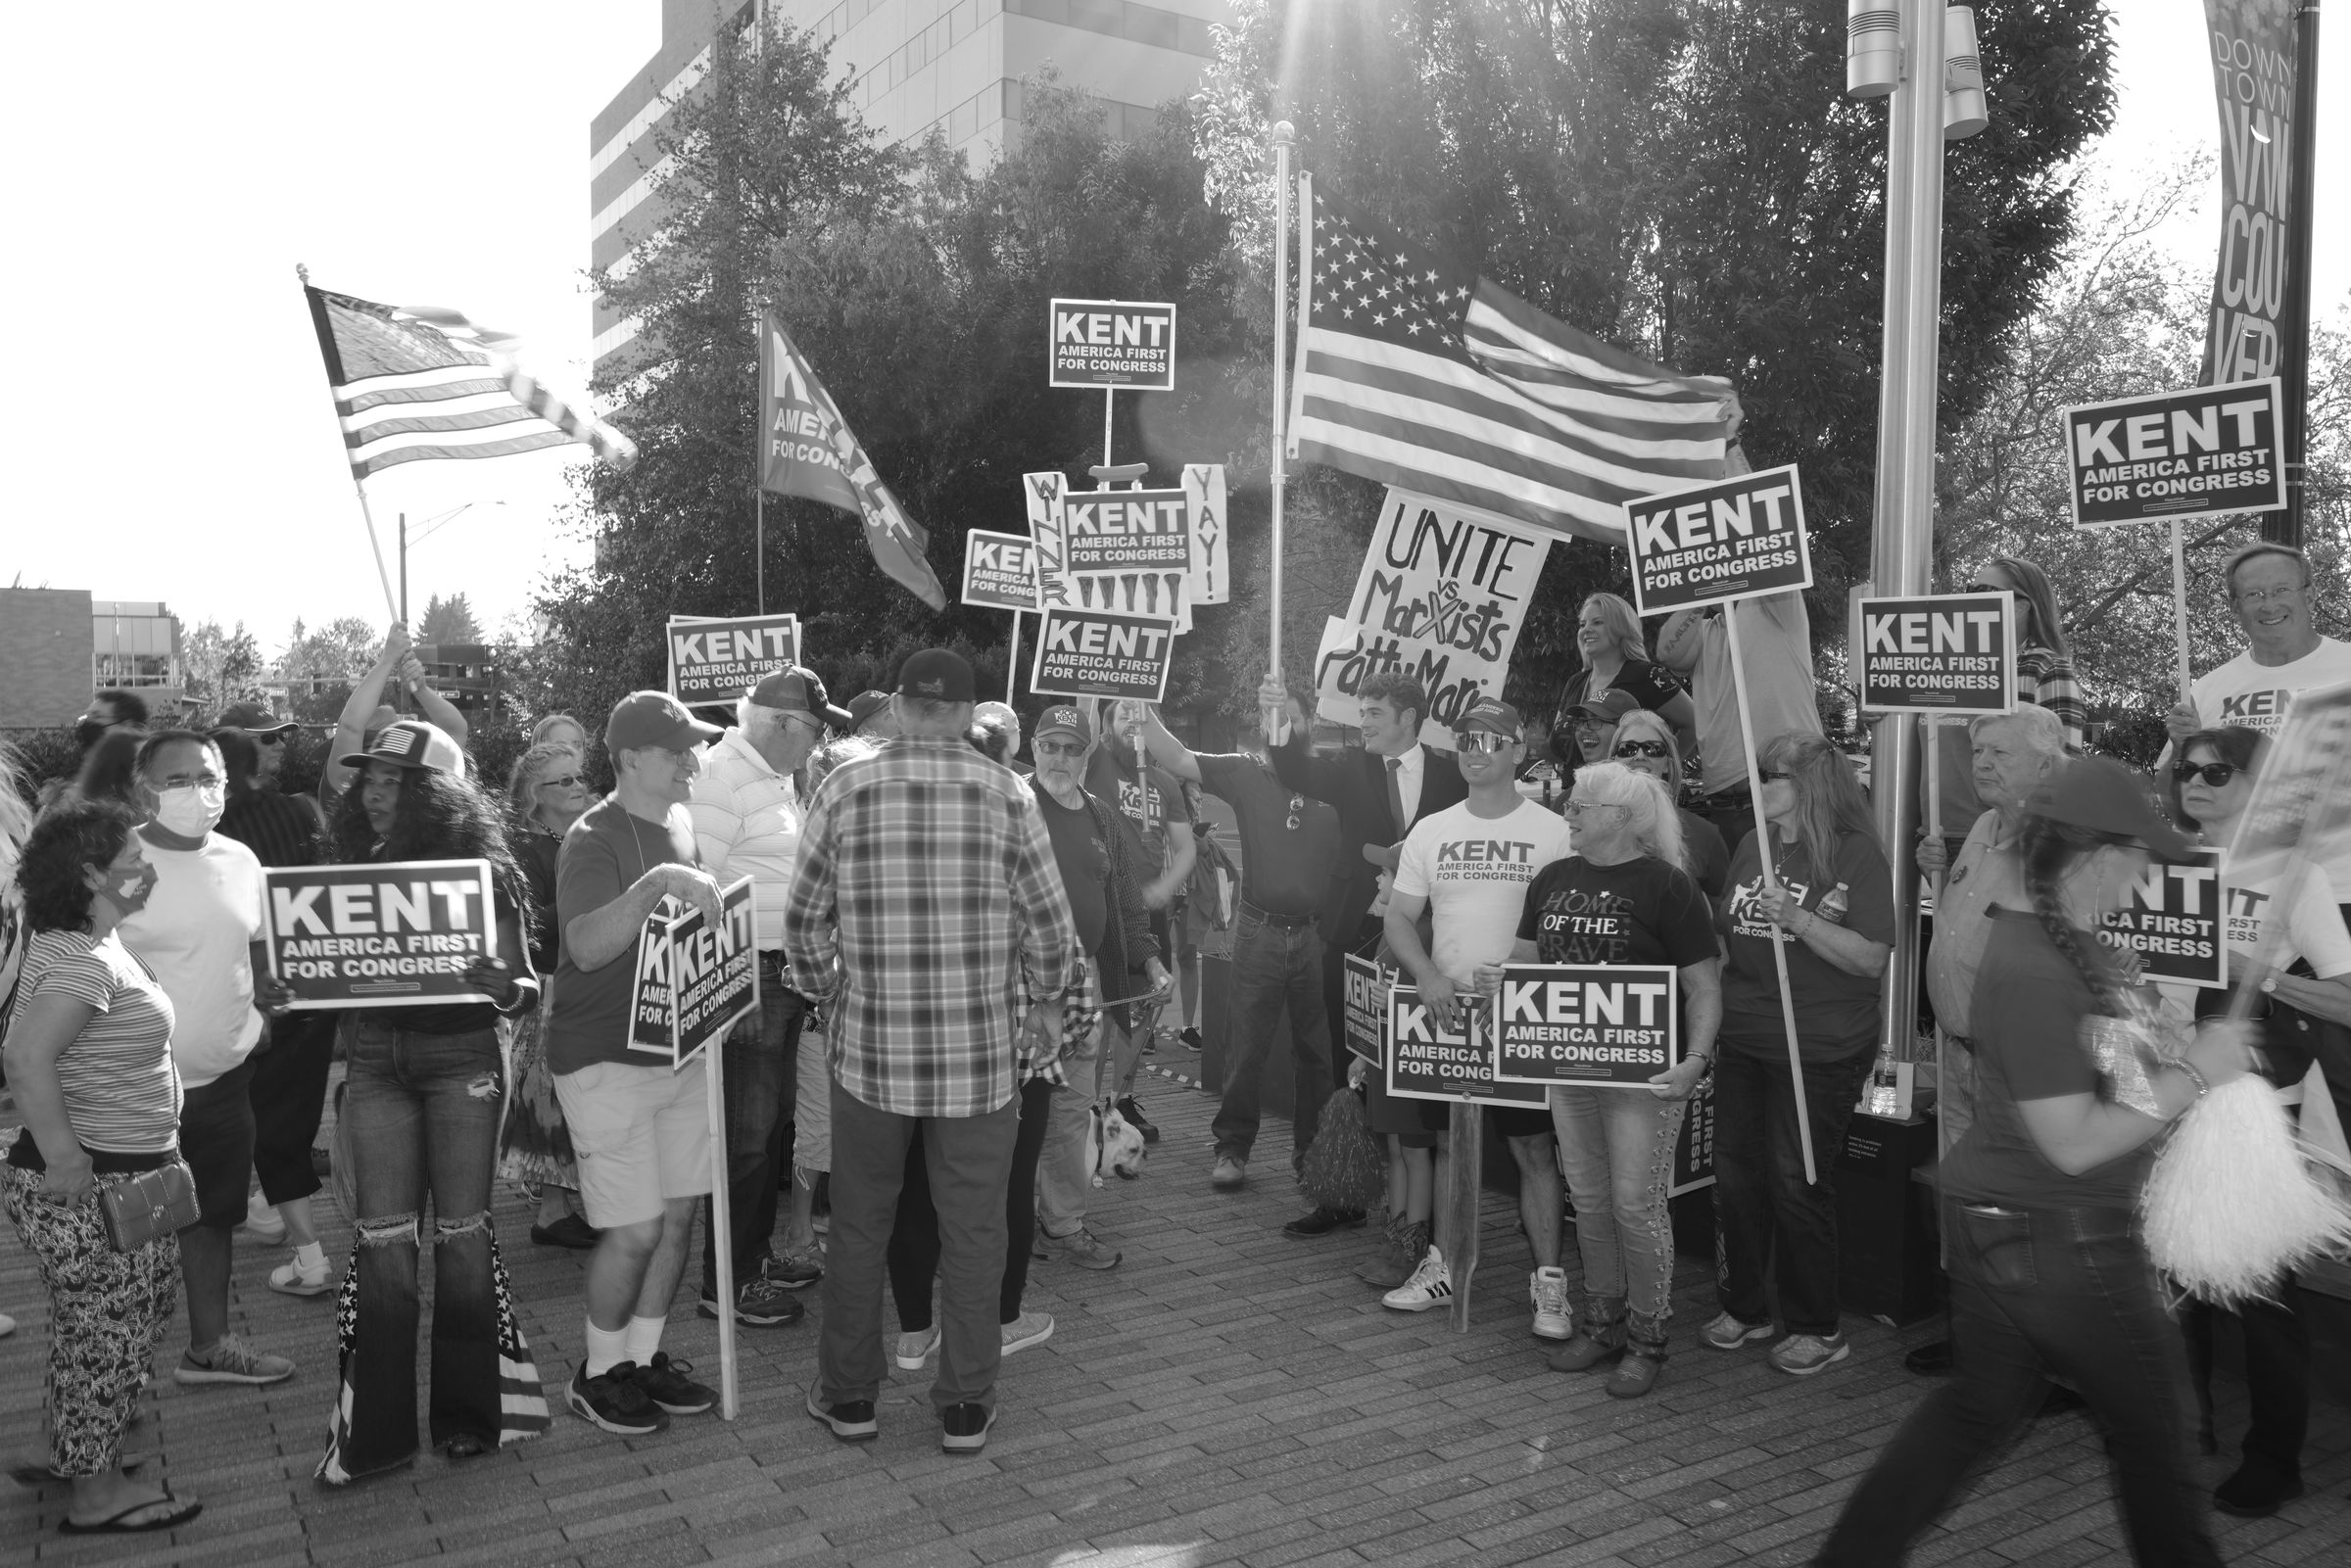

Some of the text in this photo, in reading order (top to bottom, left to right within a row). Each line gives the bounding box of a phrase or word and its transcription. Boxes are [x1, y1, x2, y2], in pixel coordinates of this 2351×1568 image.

[2215, 31, 2291, 86] DOWN
[2219, 64, 2290, 120] TOWN
[2223, 99, 2289, 221] VAN
[2222, 203, 2285, 321] COU
[1058, 312, 1169, 347] KENT
[1058, 345, 1167, 359] AMERICA FIRST
[1058, 358, 1166, 373] FOR CONGRESS
[2076, 399, 2269, 467] KENT
[772, 439, 795, 459] FOR
[2083, 449, 2270, 486] AMERICA FIRST
[2084, 468, 2271, 504] FOR CONGRESS
[1066, 500, 1186, 536] KENT
[1634, 484, 1790, 556] KENT
[1029, 474, 1071, 606] WINNER
[1071, 535, 1186, 549] AMERICA FIRST
[1192, 466, 1219, 600] YAY!
[1071, 547, 1187, 562] FOR CONGRESS
[1385, 502, 1535, 601] UNITE
[1644, 531, 1794, 573] AMERICA FIRST
[973, 569, 1029, 586] AMERICA
[1645, 571, 1683, 591] FOR
[1688, 549, 1798, 583] CONGRESS
[971, 580, 1035, 597] FOR CONG
[1046, 619, 1169, 659] KENT
[1865, 611, 2000, 653] KENT
[673, 627, 791, 665] KENT
[680, 661, 746, 678] AMERICA
[1046, 653, 1161, 673] AMERICA FIRST
[1869, 656, 1999, 671] AMERICA FIRST
[680, 678, 710, 690] FOR
[1043, 666, 1157, 686] FOR CONGRESS
[1869, 674, 1999, 689] FOR CONGRESS
[2220, 689, 2293, 720] KEN
[1437, 840, 1535, 863] KENT
[1437, 863, 1534, 874] AMERICA FIRST
[1437, 872, 1534, 883] FOR CONGRESS
[2119, 864, 2215, 915] NT
[272, 880, 481, 936] KENT
[1542, 891, 1635, 915] HOME
[1544, 915, 1619, 934] OF THE
[1733, 926, 1751, 936] FOR
[2141, 914, 2214, 936] FIRST
[2229, 918, 2261, 929] RST
[283, 933, 481, 958] AMERICA FIRST
[675, 897, 750, 993] KENT
[2095, 930, 2214, 959] ONGRESS
[283, 961, 337, 979] FOR
[680, 947, 751, 1014] AMERICA FIRST
[642, 984, 673, 1005] AMER
[680, 1014, 700, 1036] FOR
[702, 968, 753, 1018] CONGRESS
[1504, 980, 1666, 1026] KENT
[639, 1005, 662, 1024] FOR
[1506, 1025, 1664, 1045] AMERICA FIRST
[1399, 1044, 1481, 1064] AMERICA
[1505, 1044, 1545, 1059] FOR
[1551, 1045, 1664, 1065] CONGRESS
[1398, 1061, 1492, 1080] FOR CONG
[1703, 1105, 1714, 1167] FIRST
